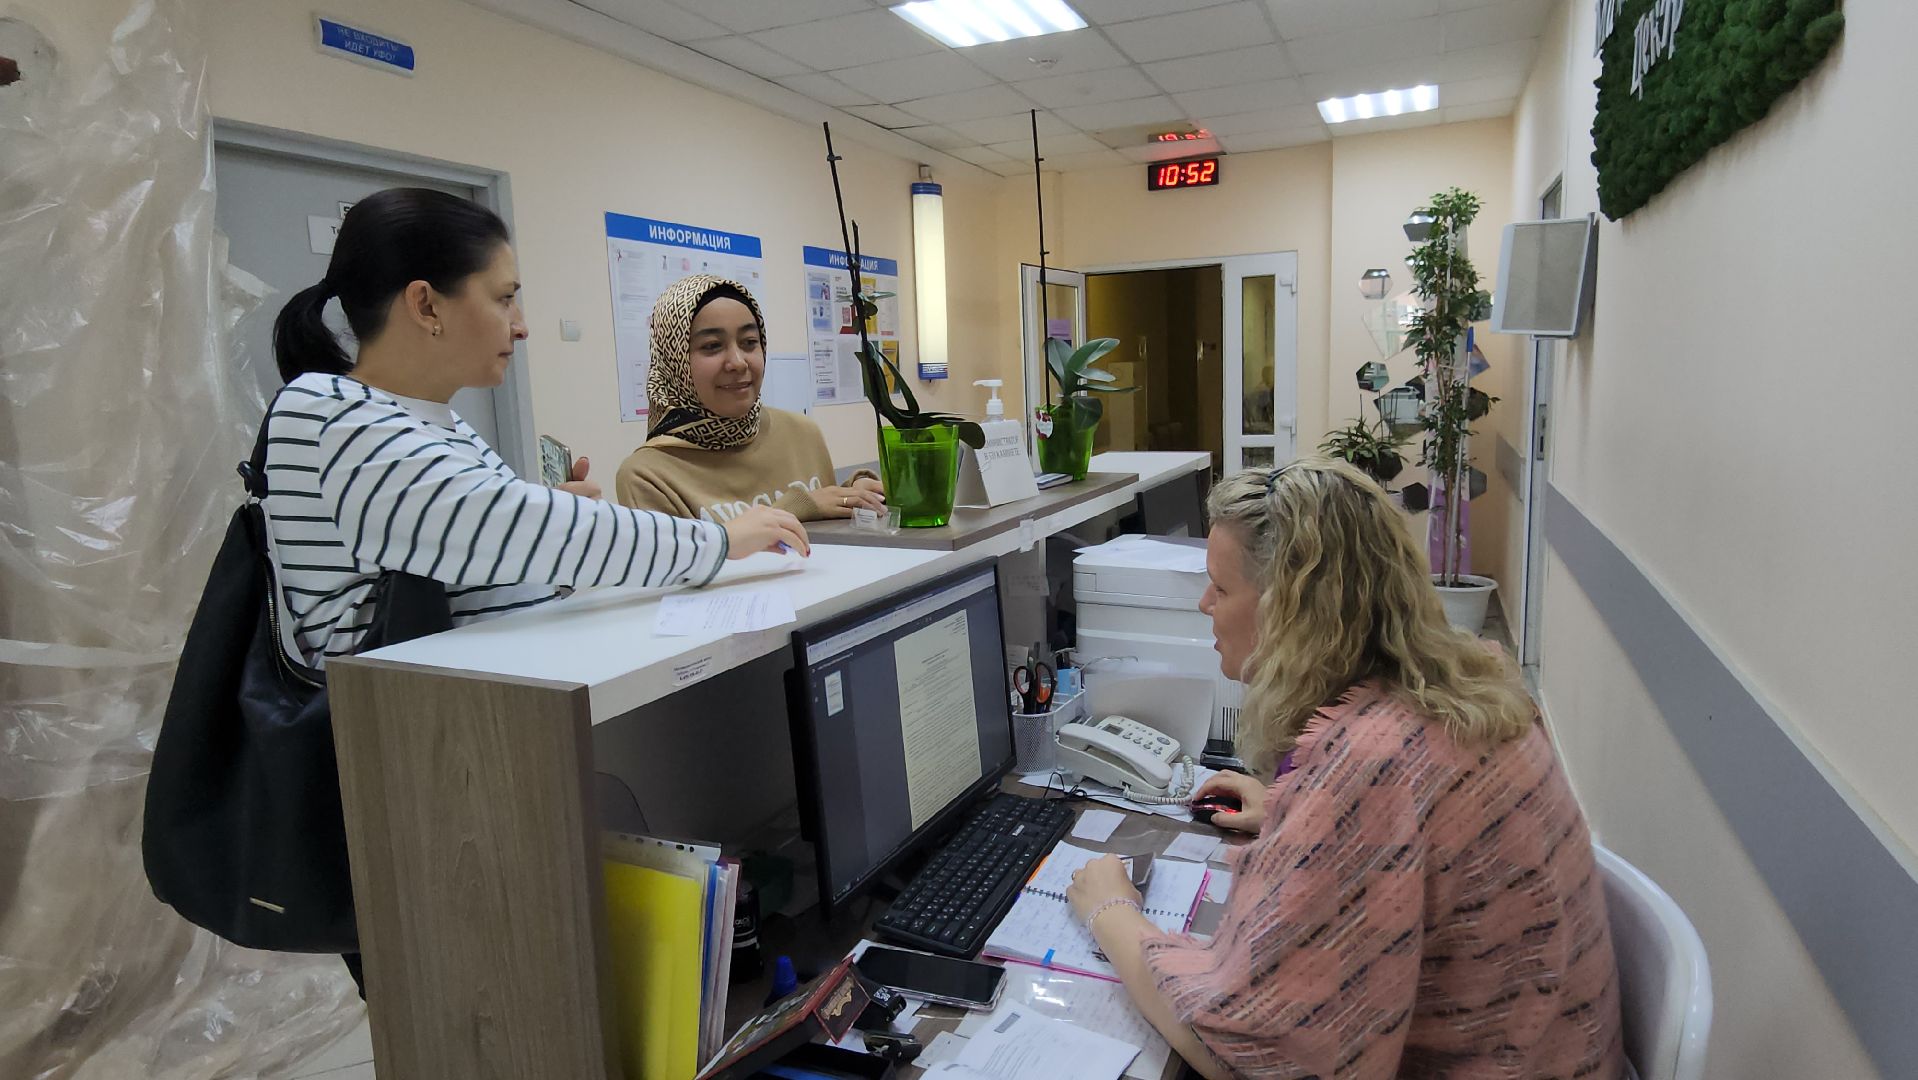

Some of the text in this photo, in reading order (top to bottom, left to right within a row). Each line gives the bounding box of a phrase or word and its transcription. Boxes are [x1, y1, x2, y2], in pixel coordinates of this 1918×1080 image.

[1158, 161, 1215, 187] 10:52
[648, 223, 732, 251] ИНФОРМАЦИЯ
[828, 253, 879, 271] ИНФОАЦИЯ
